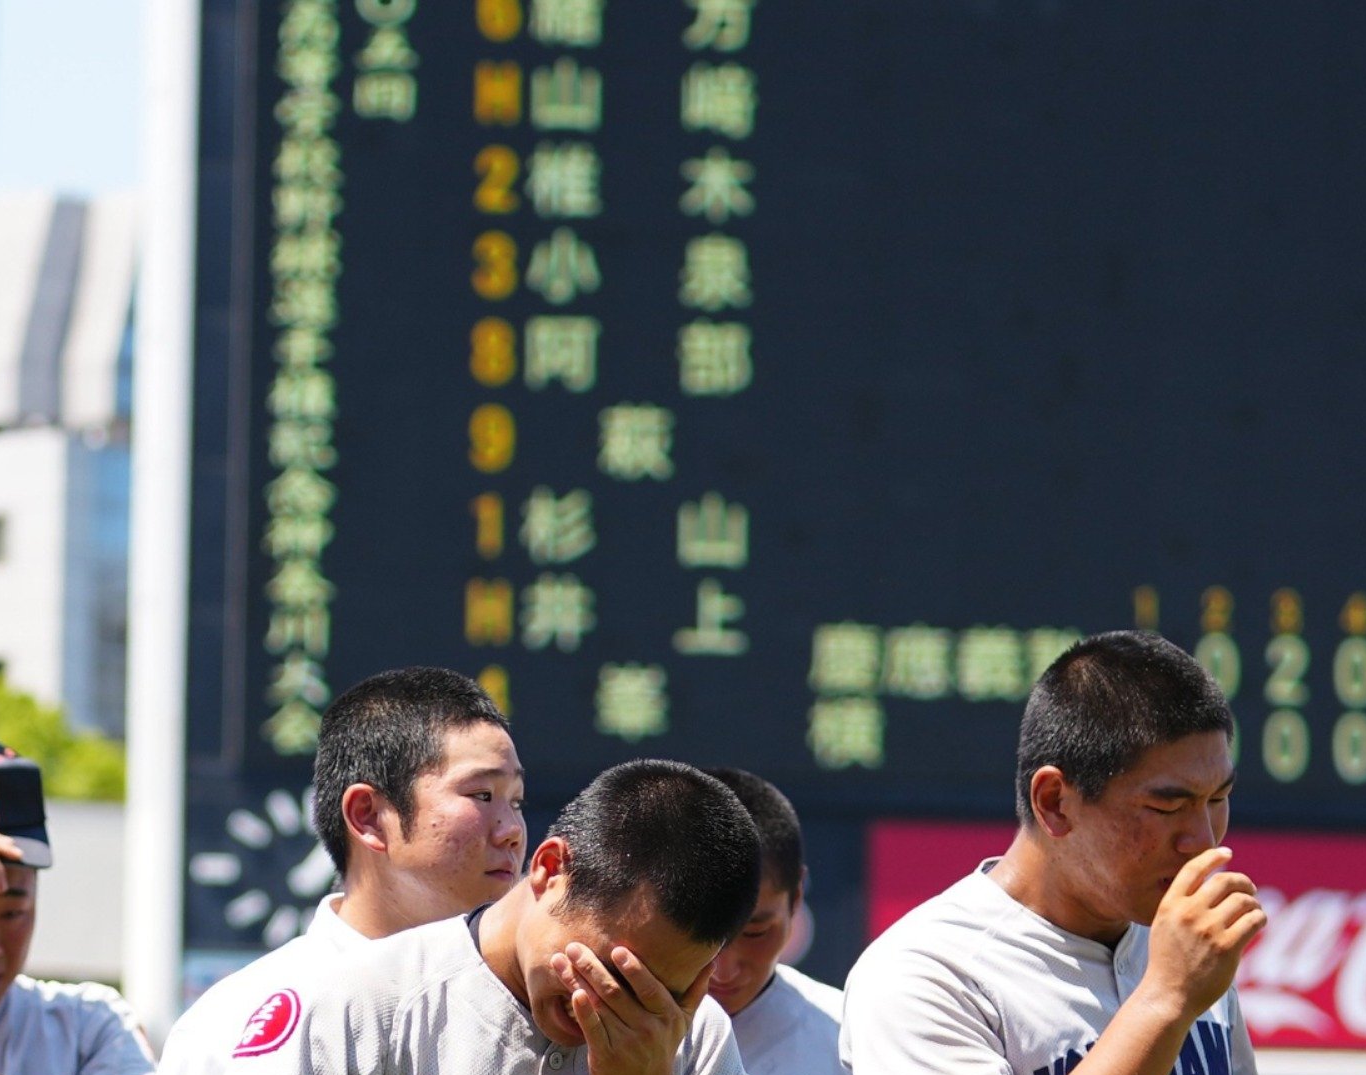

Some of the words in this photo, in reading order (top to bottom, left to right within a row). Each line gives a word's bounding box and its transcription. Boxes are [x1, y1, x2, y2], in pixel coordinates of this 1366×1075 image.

[473, 144, 520, 214] 2
[471, 230, 518, 300] 3
[470, 316, 517, 387] 8
[468, 404, 516, 473] 9
[471, 491, 505, 559] 1
[1264, 633, 1311, 706] 2
[1261, 707, 1311, 783] 0
